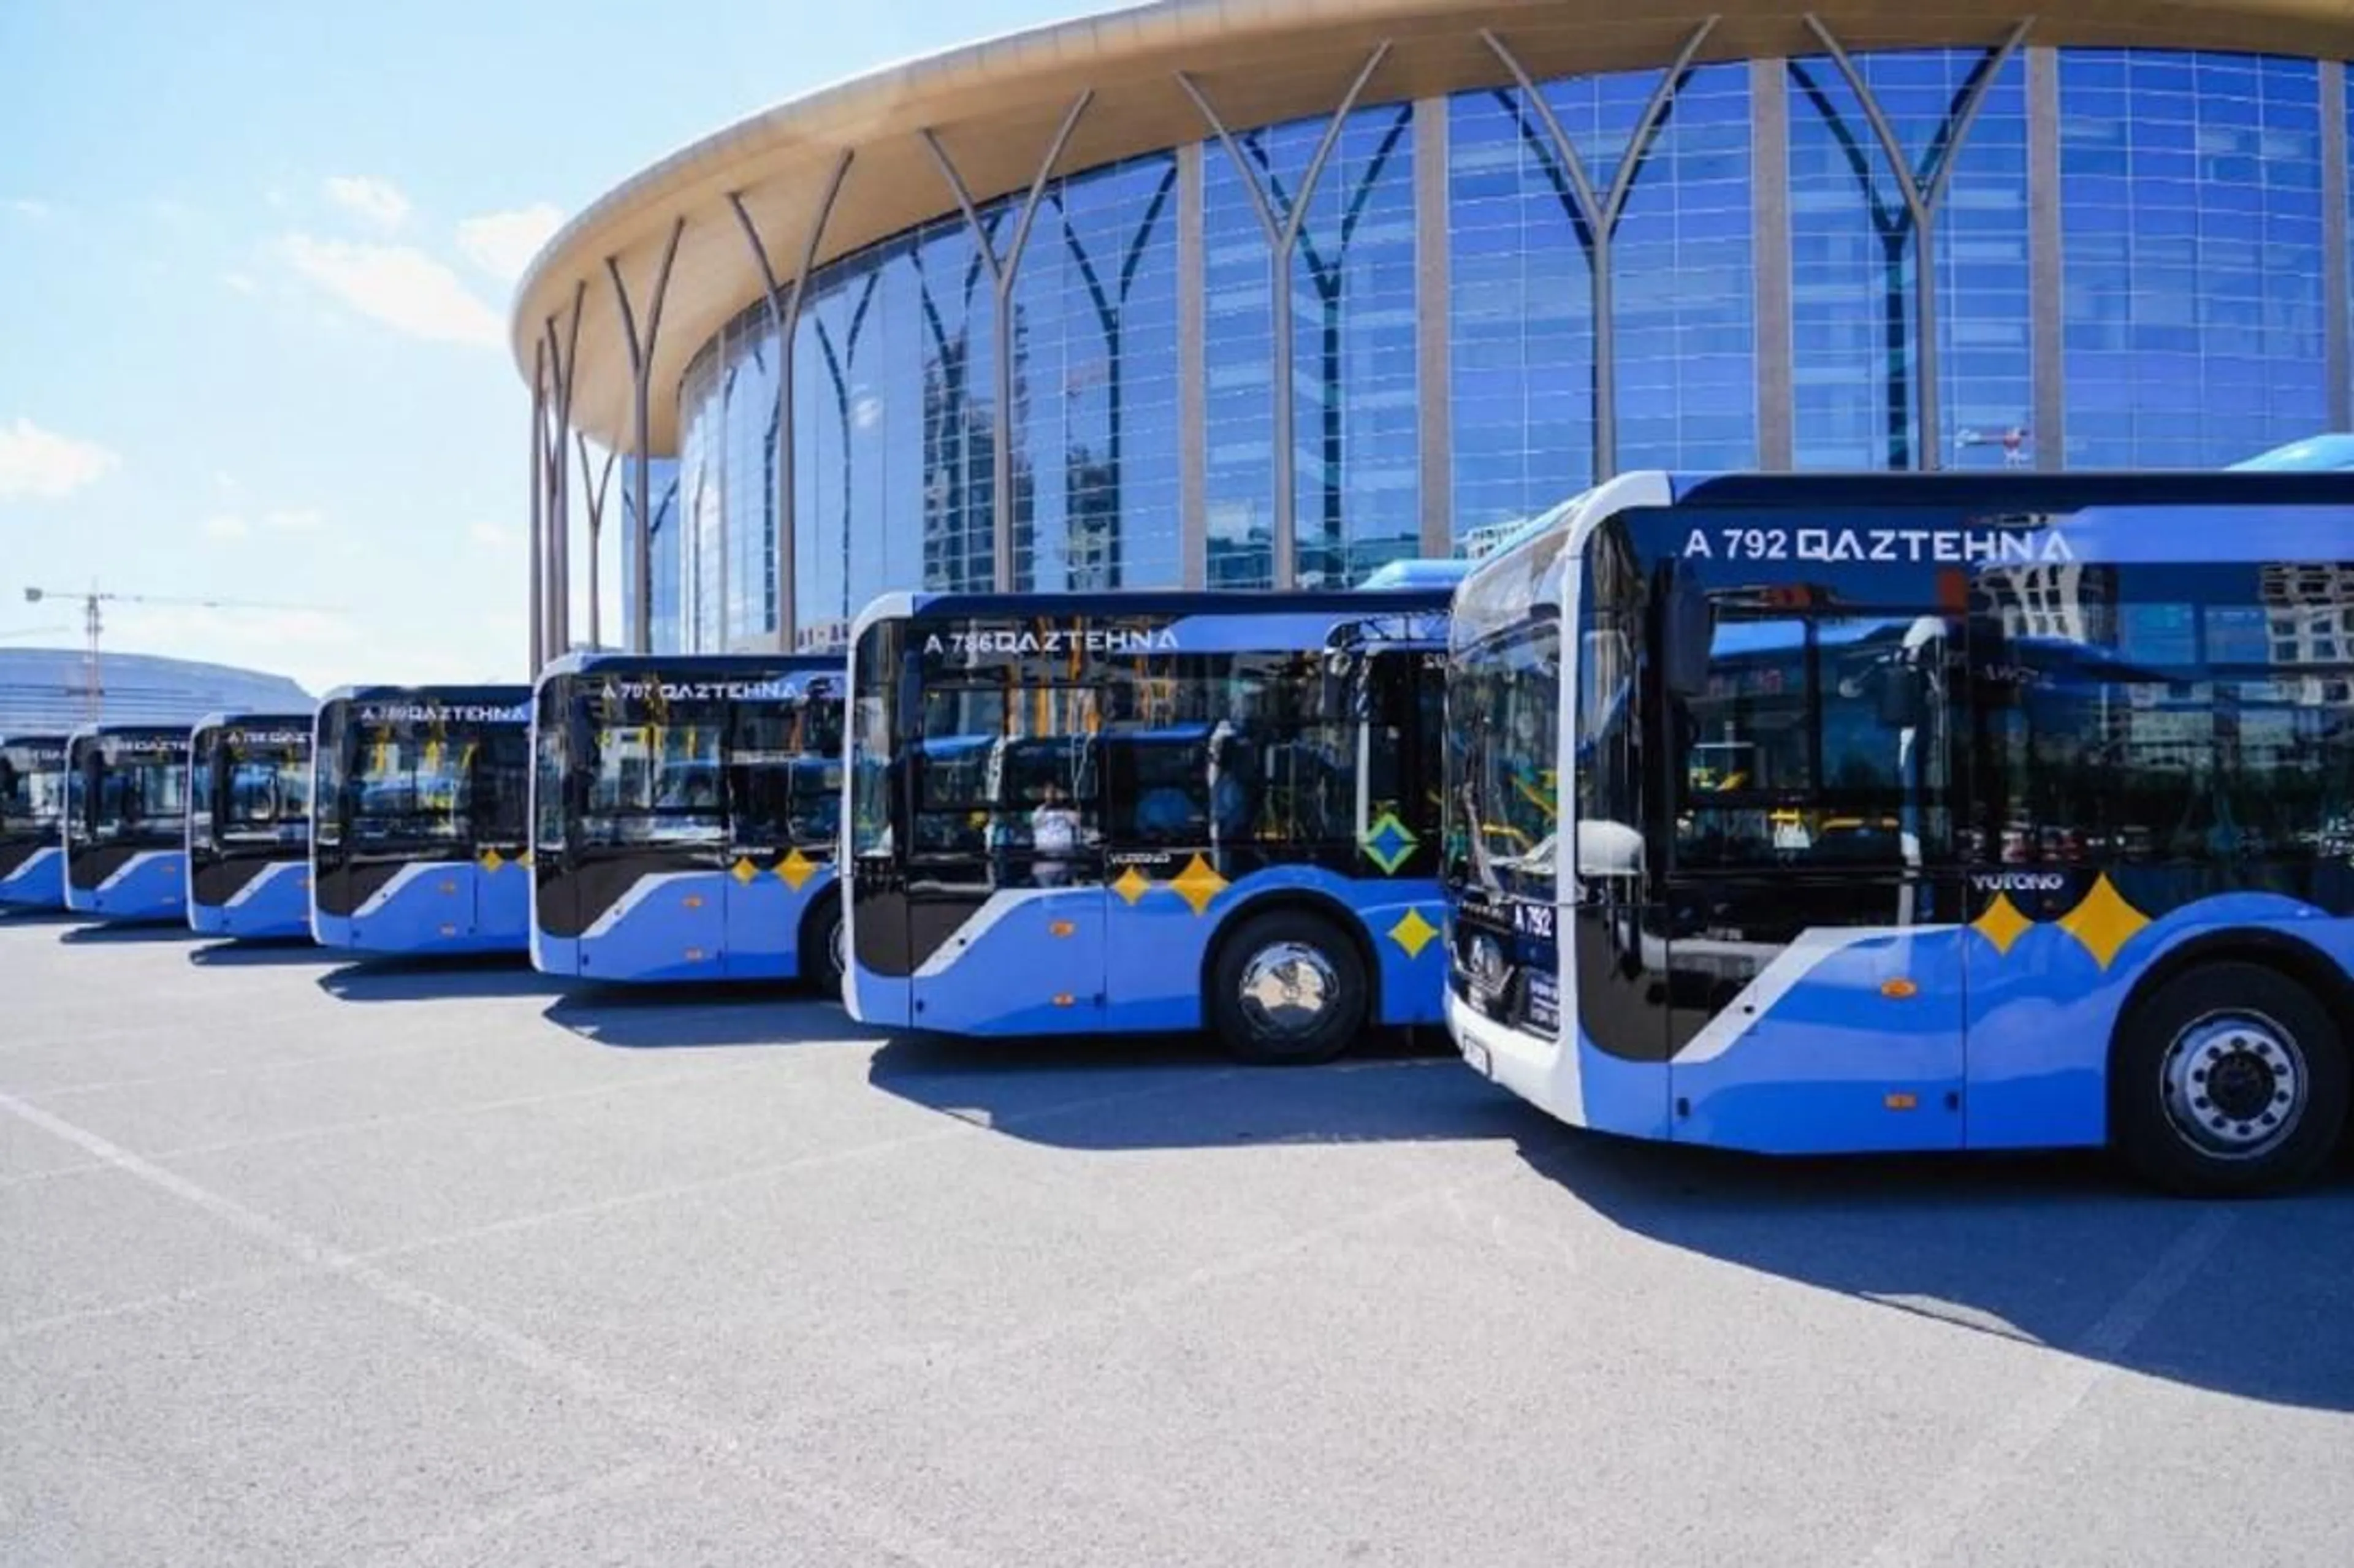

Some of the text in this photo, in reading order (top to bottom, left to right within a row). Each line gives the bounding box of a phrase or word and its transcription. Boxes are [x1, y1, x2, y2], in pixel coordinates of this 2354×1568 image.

[1683, 529, 2074, 562] A 792 QAZTEHNA
[923, 634, 944, 654] A
[994, 629, 1179, 654] QAZTEHNA
[601, 682, 617, 699] A
[659, 682, 799, 700] QAZTEHNA
